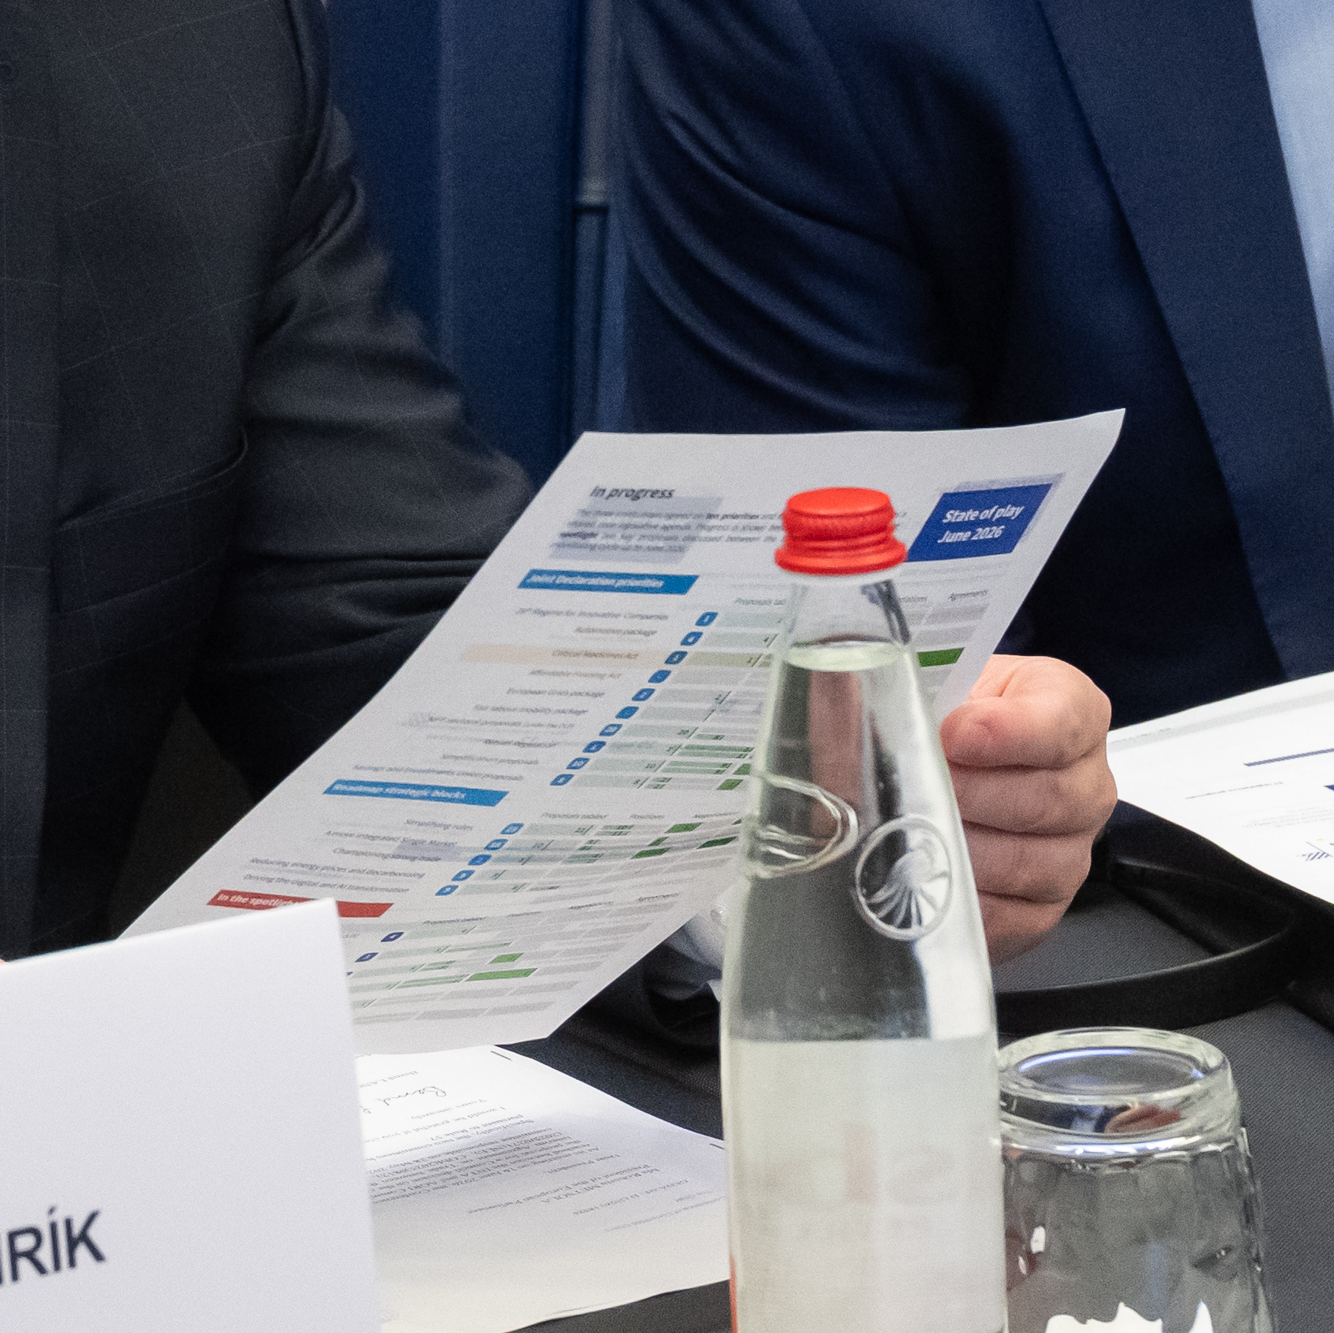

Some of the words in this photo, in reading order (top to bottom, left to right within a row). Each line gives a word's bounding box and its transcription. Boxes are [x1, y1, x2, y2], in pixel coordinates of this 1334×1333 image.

[605, 487, 676, 501] progress
[941, 508, 980, 524] State
[980, 505, 998, 521] of
[997, 502, 1026, 523] play
[936, 527, 972, 544] June
[972, 524, 1006, 541] 2026
